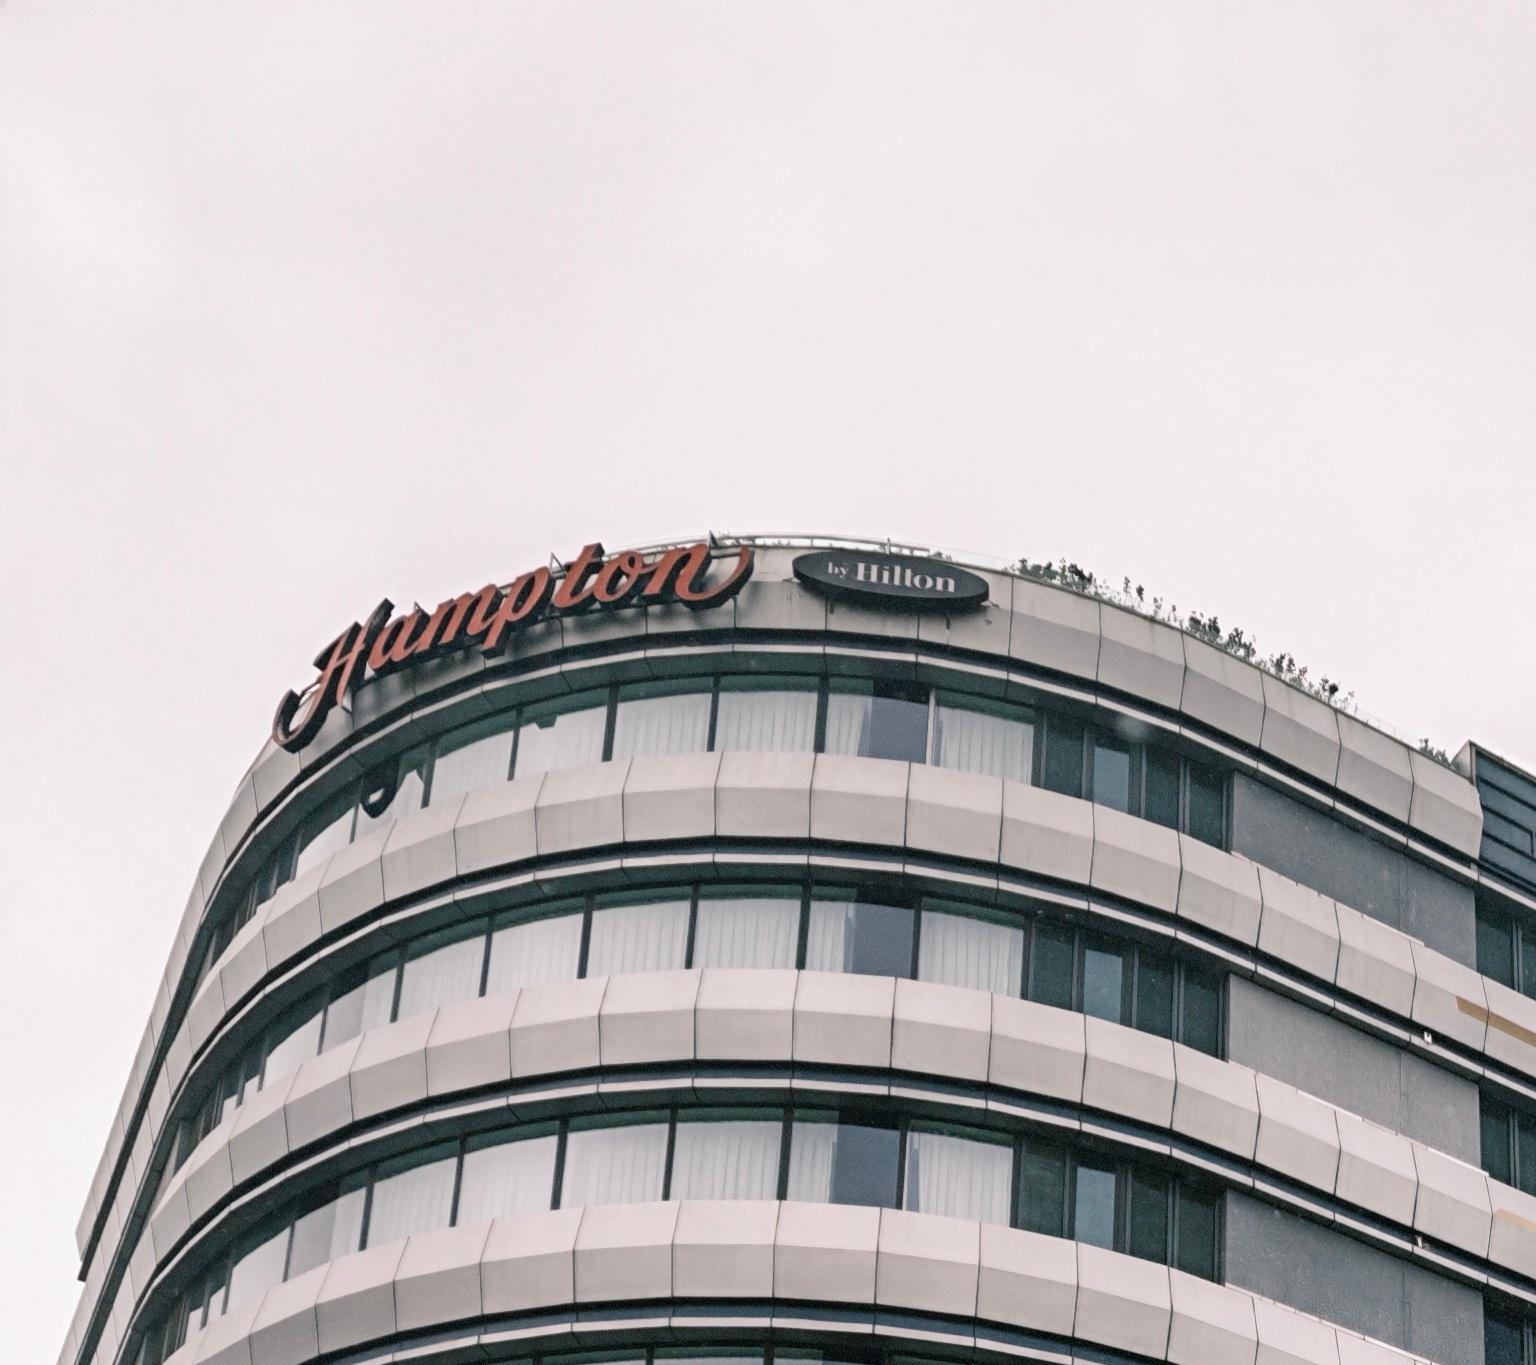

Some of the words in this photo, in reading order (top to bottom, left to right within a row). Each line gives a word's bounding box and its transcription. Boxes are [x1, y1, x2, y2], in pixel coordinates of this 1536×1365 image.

[827, 561, 848, 579] by
[856, 562, 956, 593] Hilton
[272, 542, 755, 753] Hampton
